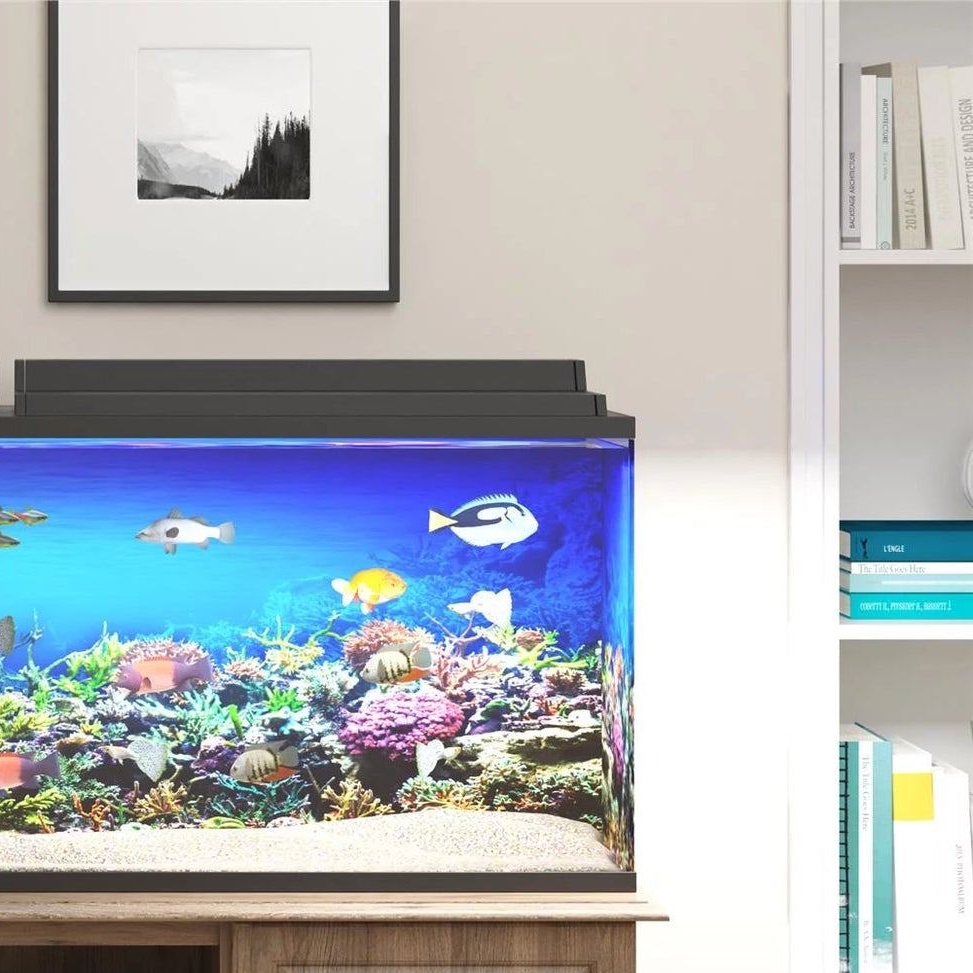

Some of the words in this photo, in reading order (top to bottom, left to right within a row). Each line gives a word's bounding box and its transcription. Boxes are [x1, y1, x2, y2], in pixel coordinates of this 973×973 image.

[958, 98, 973, 132] DESIGN
[848, 152, 856, 194] ARCHITECTURE
[848, 195, 856, 229] BACKSTAGE
[905, 208, 917, 231] 2014
[883, 545, 905, 553] L'ENGLE
[858, 564, 872, 573] The
[874, 564, 888, 573] Title
[890, 564, 907, 573] Goes
[909, 564, 926, 573] Here
